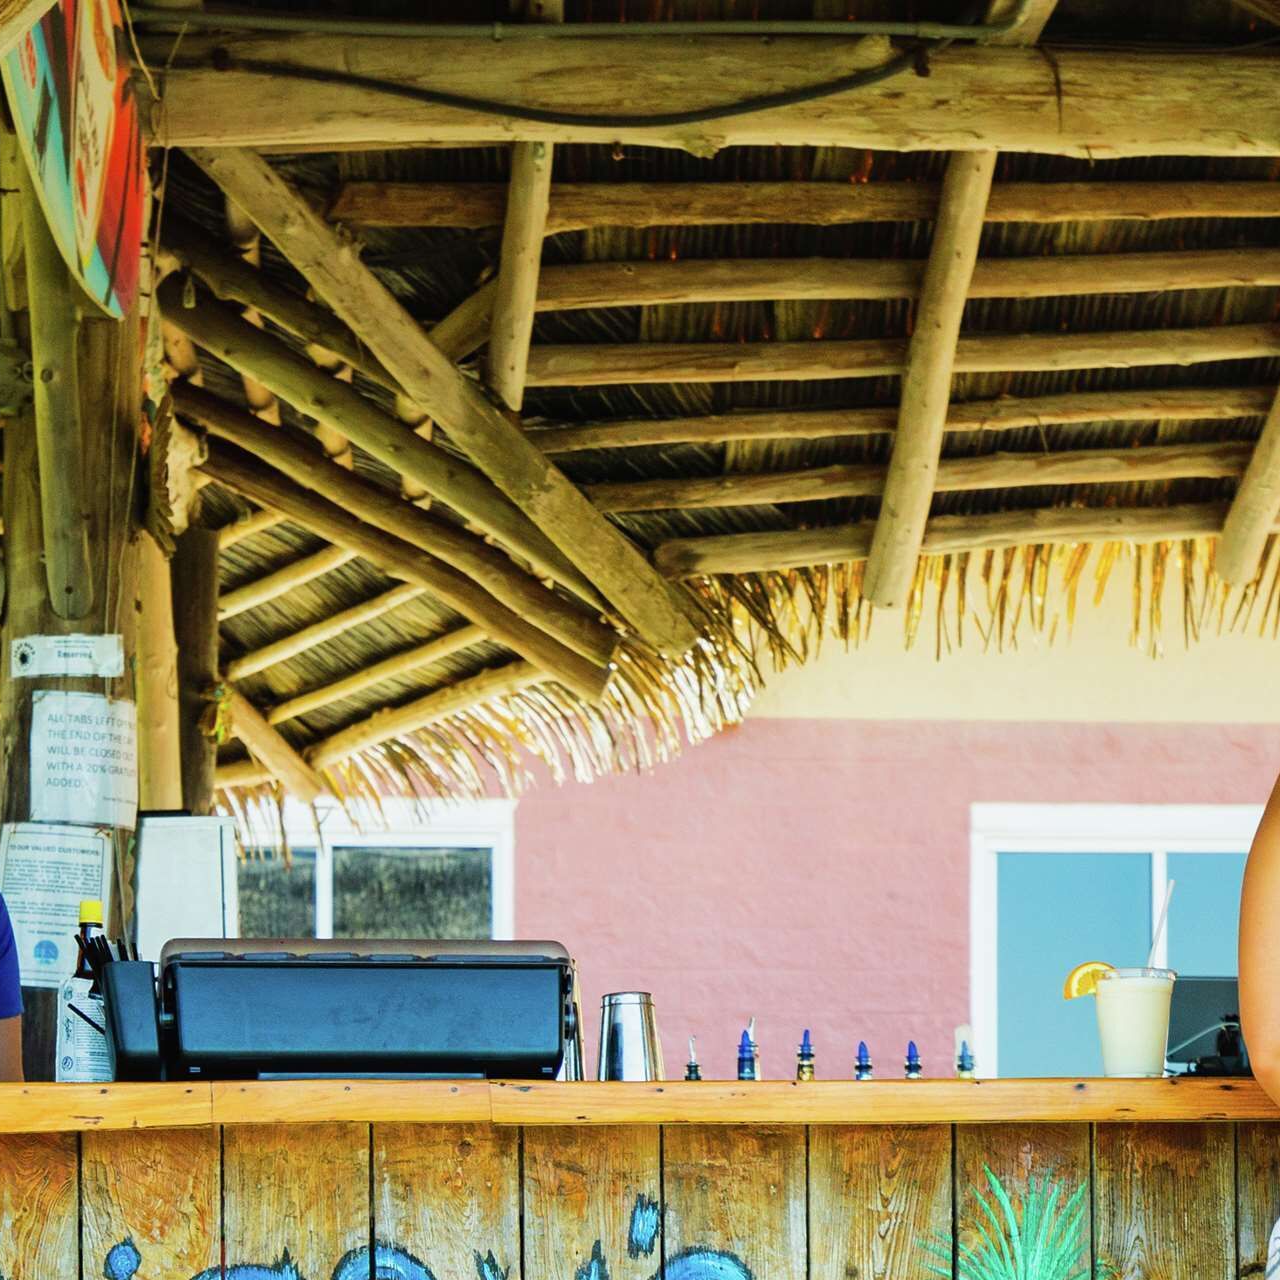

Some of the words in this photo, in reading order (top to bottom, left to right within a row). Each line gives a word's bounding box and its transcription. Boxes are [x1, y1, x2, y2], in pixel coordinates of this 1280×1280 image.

[66, 714, 93, 725] TABS
[47, 745, 71, 755] WILL
[46, 761, 74, 771] WITH
